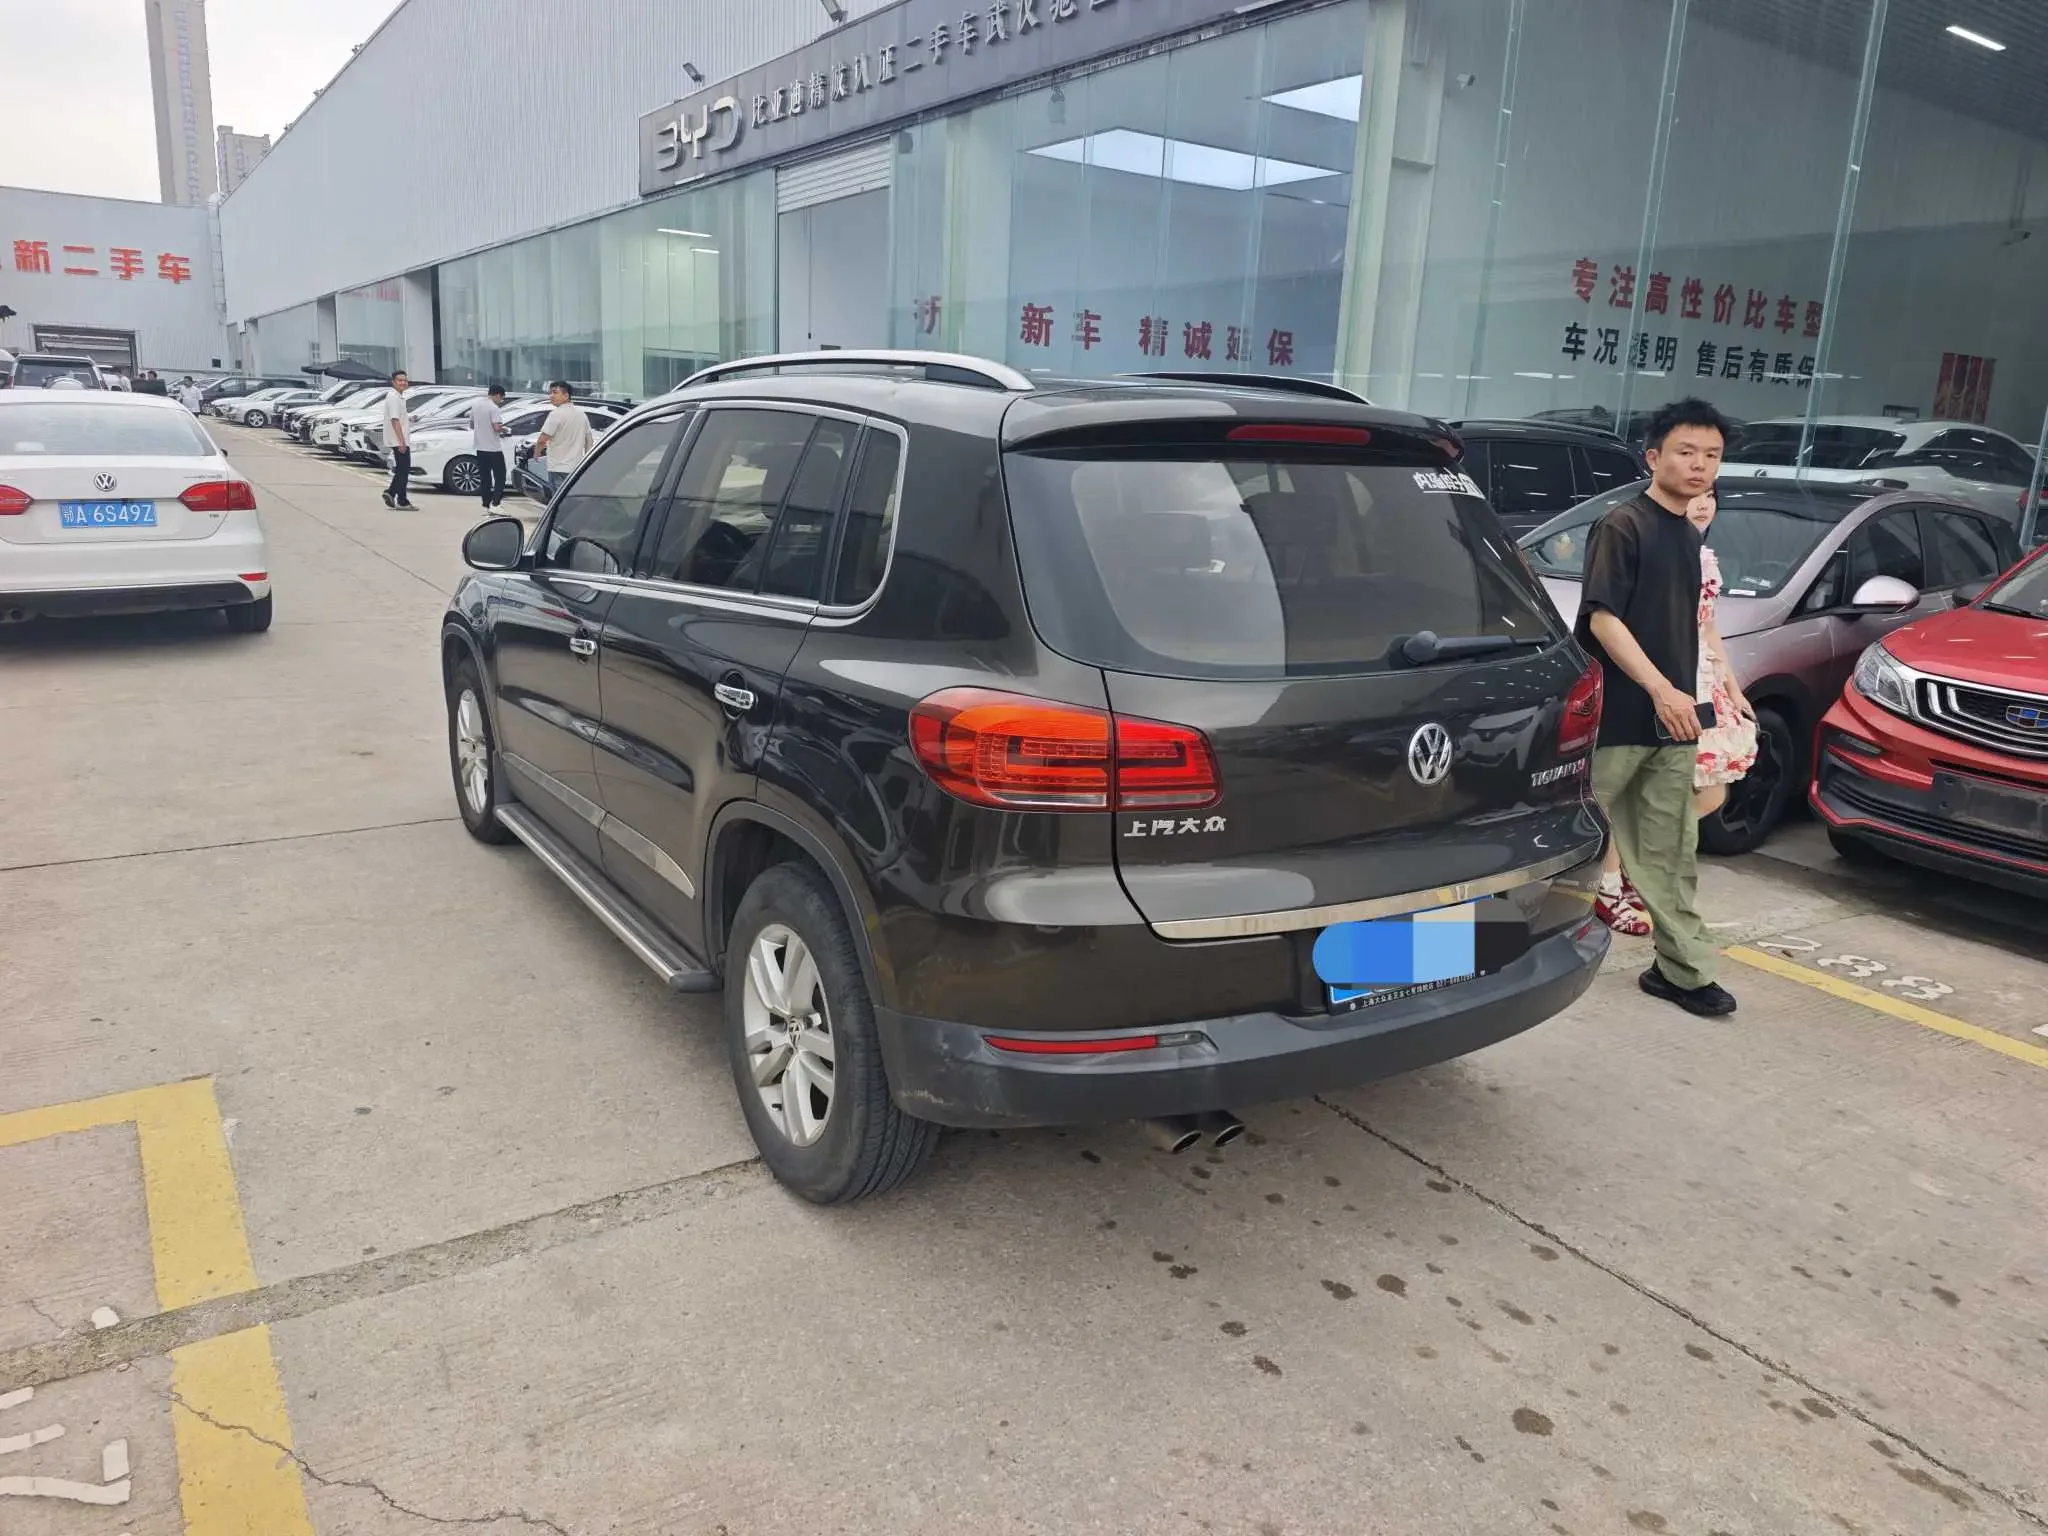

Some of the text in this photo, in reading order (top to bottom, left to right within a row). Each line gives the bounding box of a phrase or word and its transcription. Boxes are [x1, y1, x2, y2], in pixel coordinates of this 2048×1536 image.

[1573, 257, 1826, 337] 专注高性价比车型
[1562, 321, 1817, 388] 车况透明 售后有质保
[1123, 815, 1227, 837] 上汽大众
